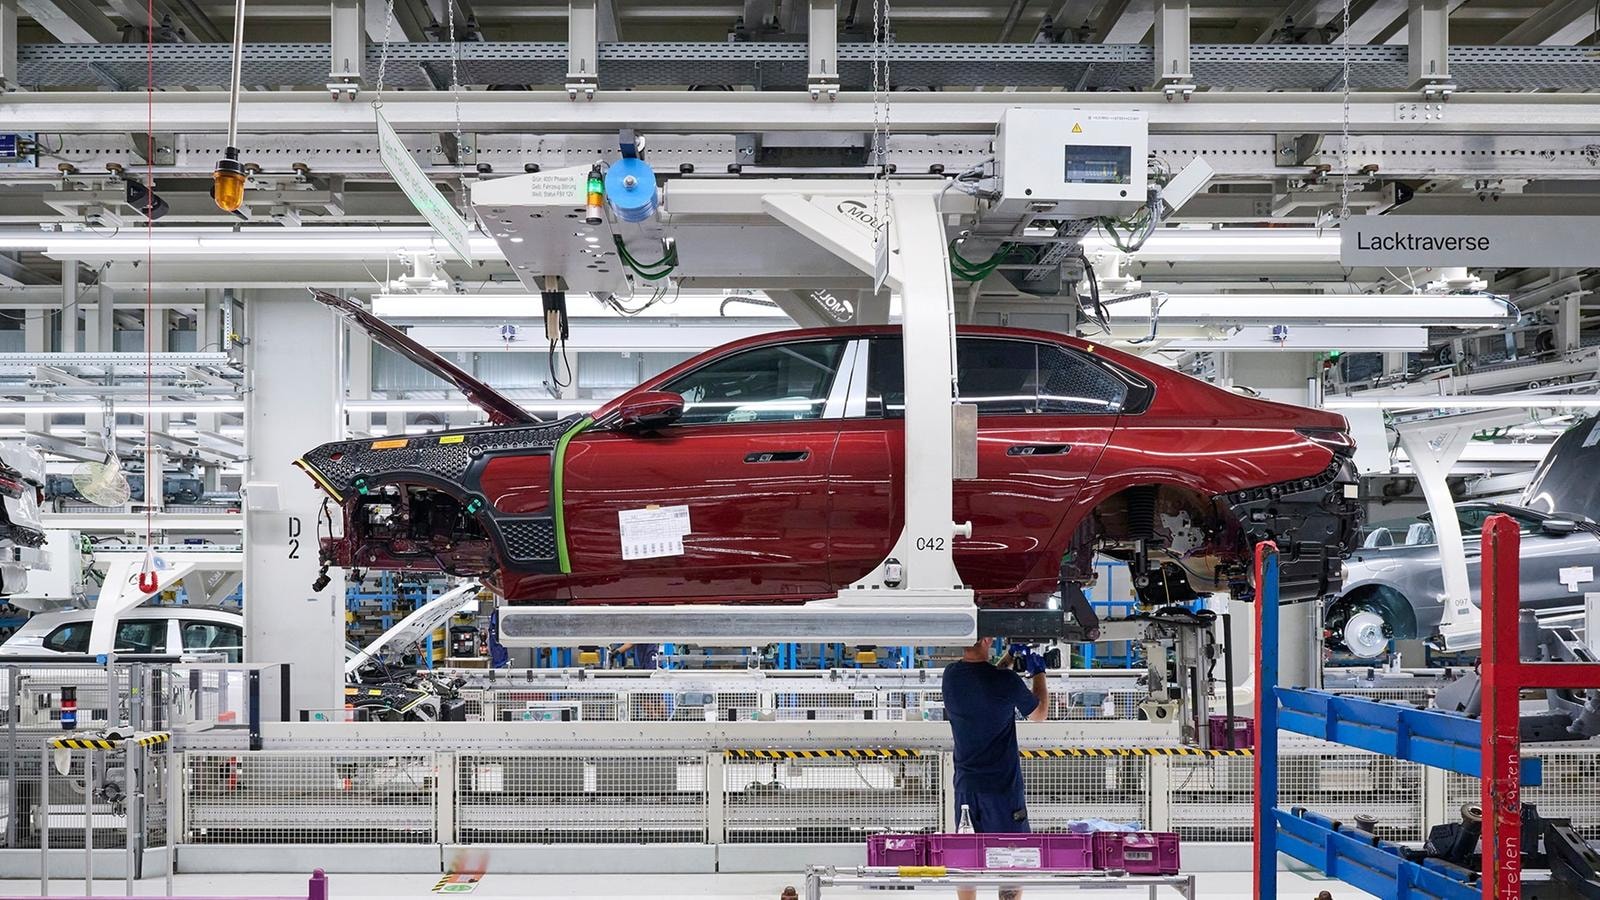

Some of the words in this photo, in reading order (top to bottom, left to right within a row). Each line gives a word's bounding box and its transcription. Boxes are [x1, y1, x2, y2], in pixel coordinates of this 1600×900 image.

[848, 206, 885, 232] MOLL
[1358, 232, 1490, 250] Lacktraverse
[289, 517, 300, 537] D
[289, 539, 299, 558] 2
[916, 537, 944, 550] 042
[1455, 598, 1468, 607] 097
